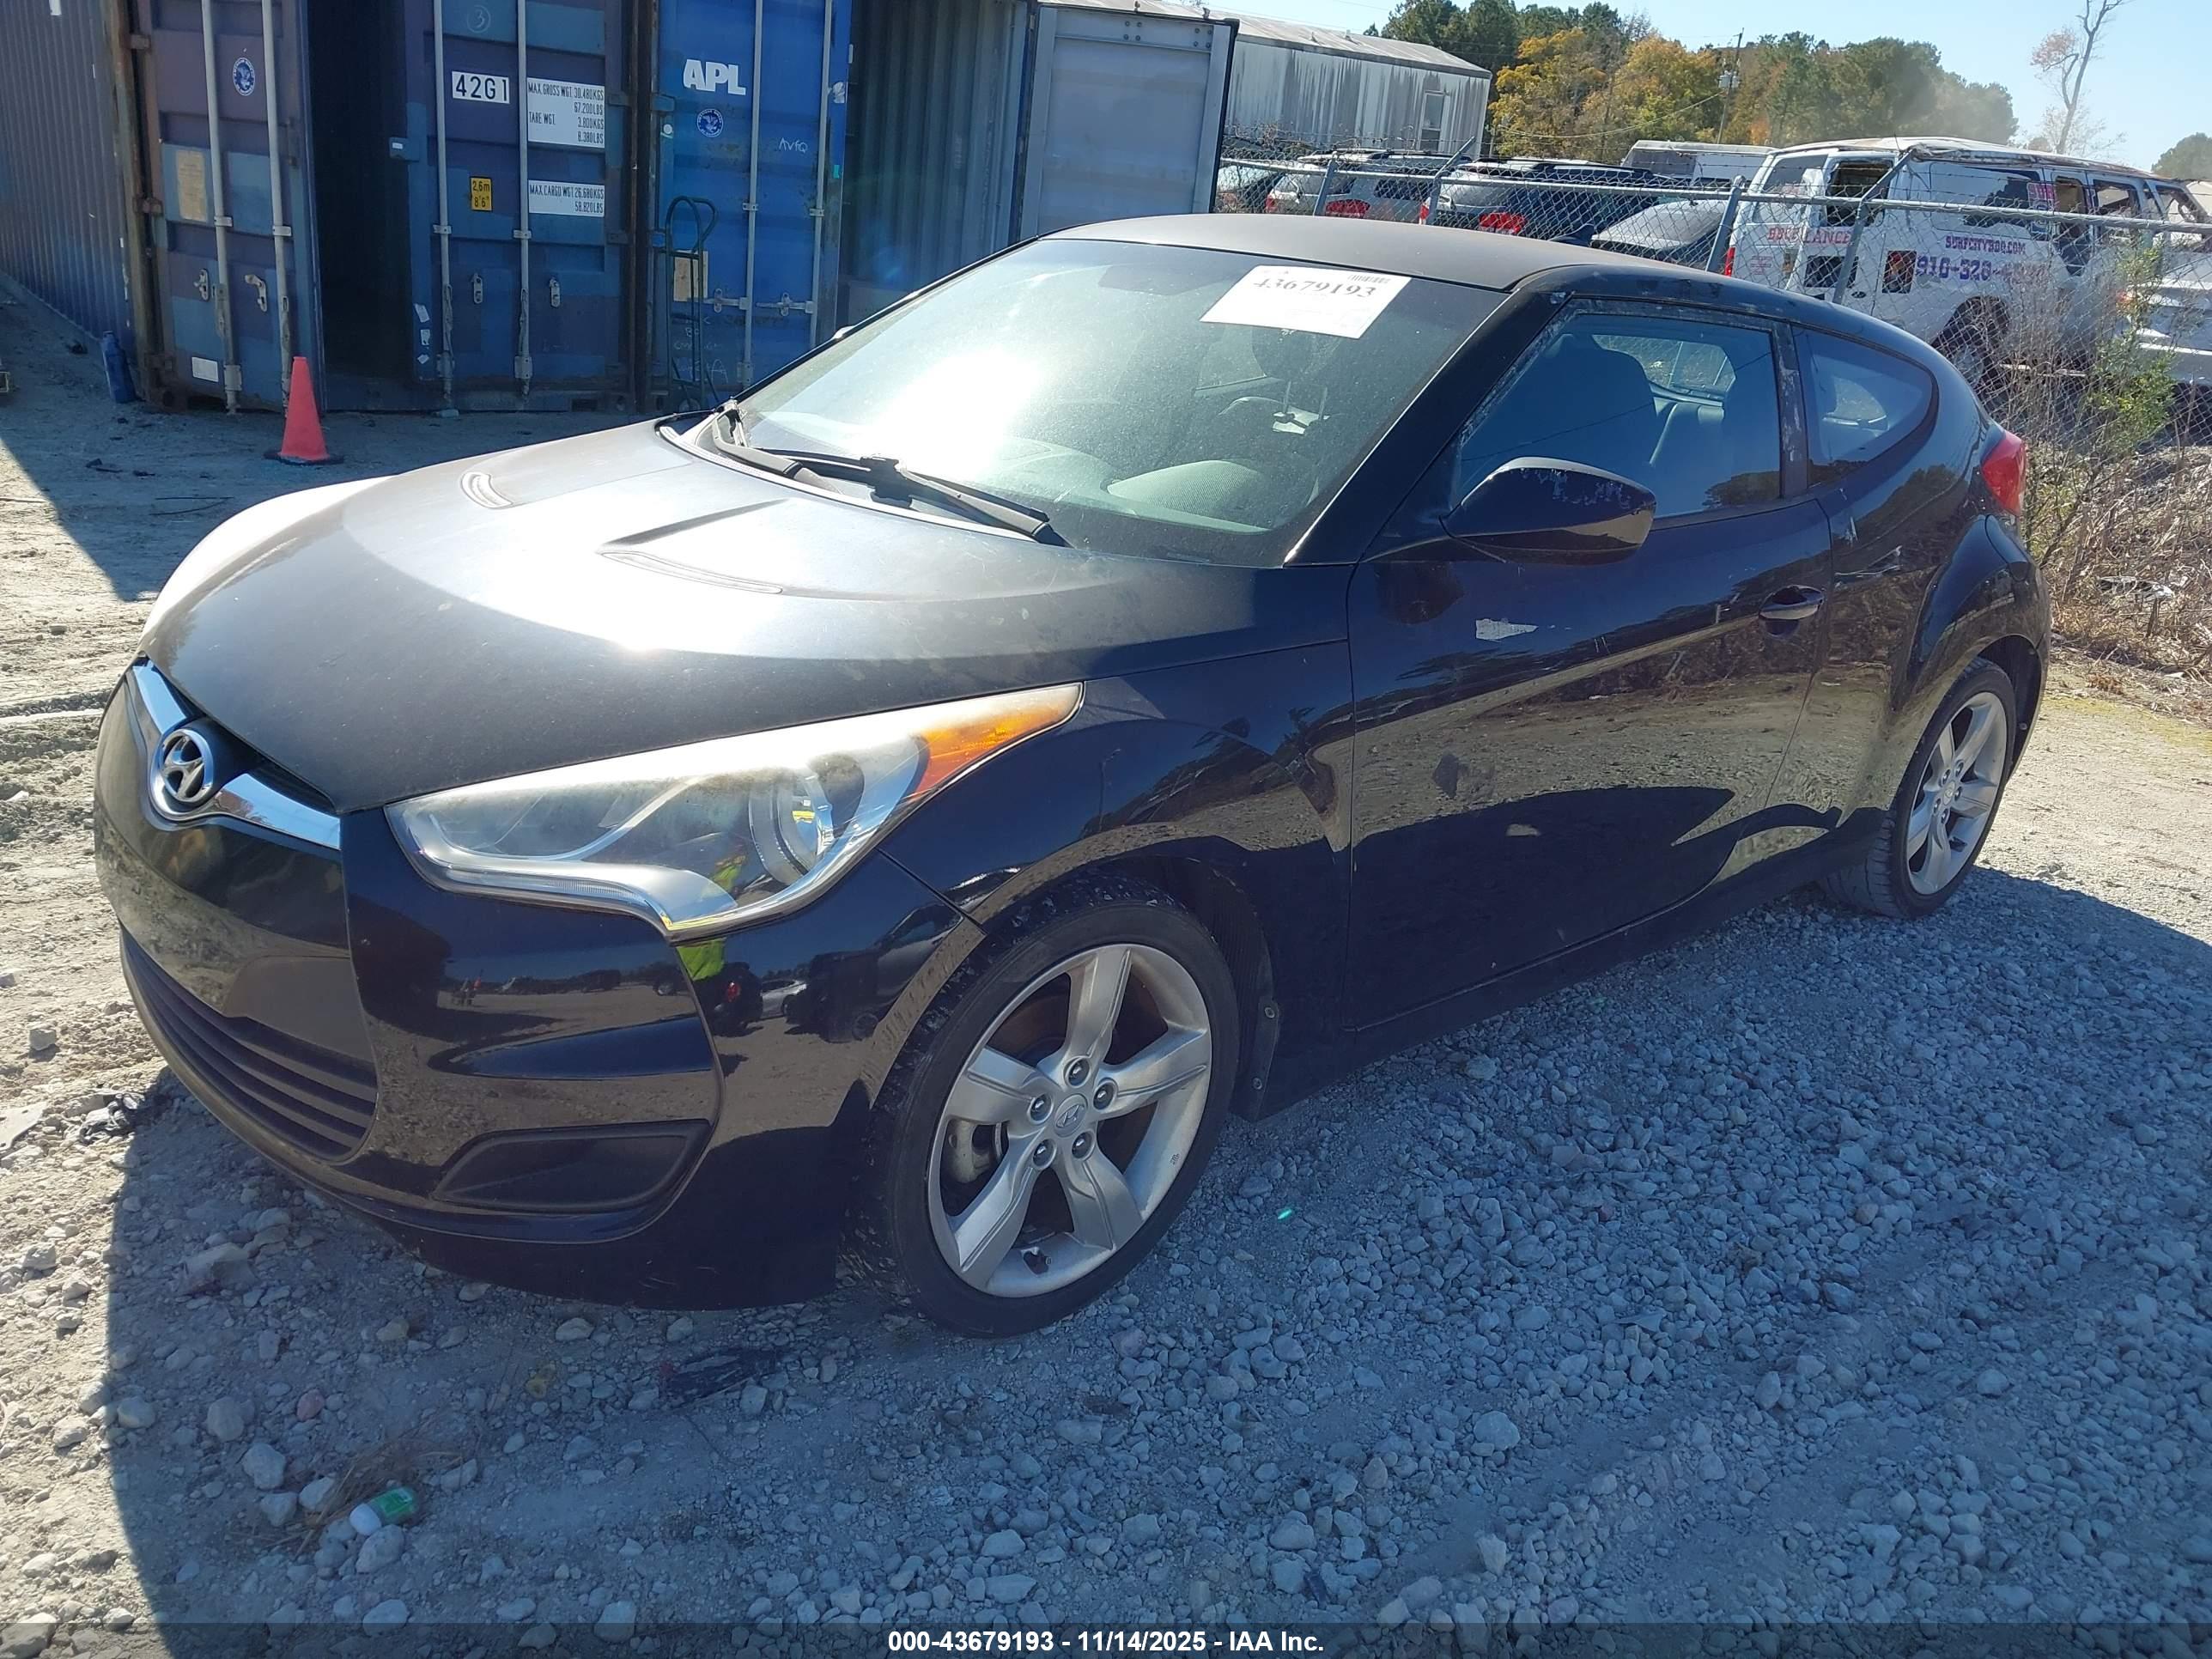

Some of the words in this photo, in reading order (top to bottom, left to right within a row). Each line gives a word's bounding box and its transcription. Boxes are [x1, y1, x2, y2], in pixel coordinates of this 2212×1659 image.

[683, 58, 746, 95] APL
[455, 74, 507, 101] 42G1
[543, 83, 560, 97] GROSS
[529, 111, 542, 125] TARE
[544, 185, 562, 198] CARGO
[1254, 277, 1376, 298] 43679193
